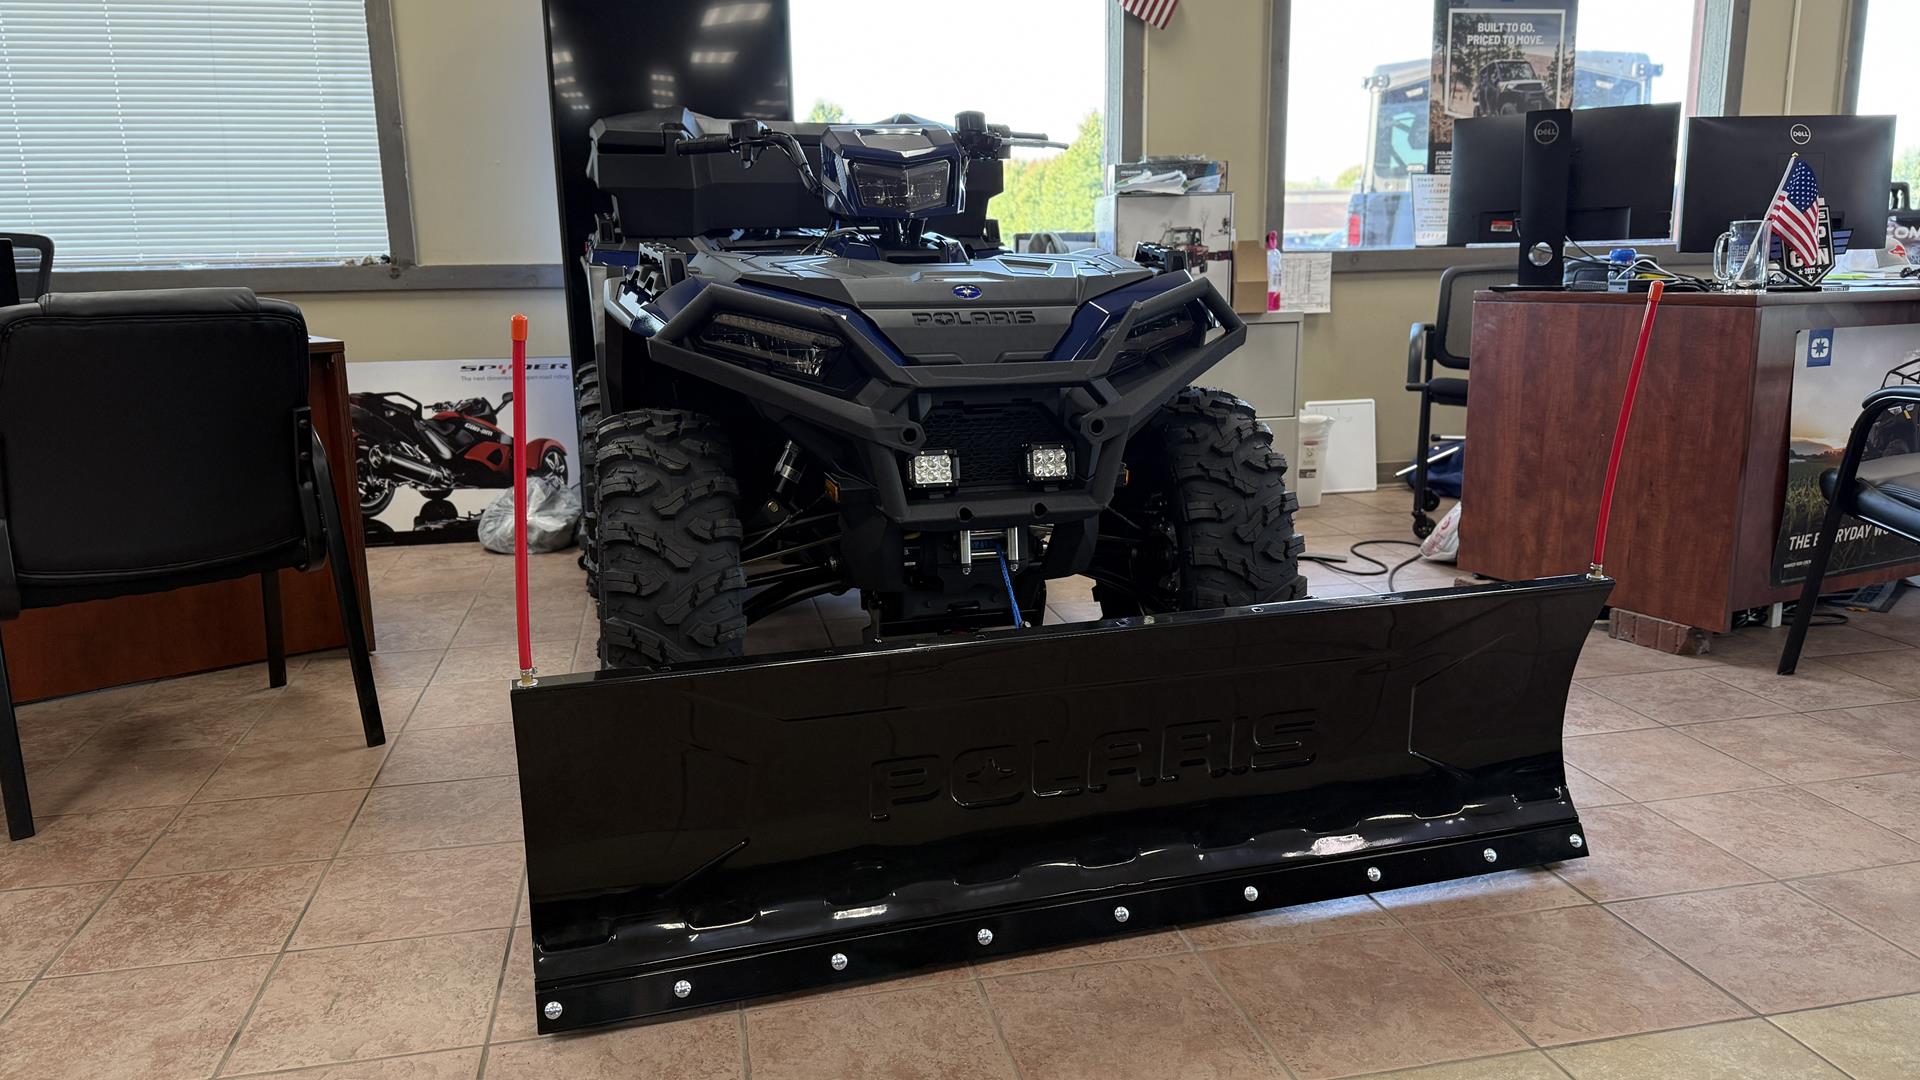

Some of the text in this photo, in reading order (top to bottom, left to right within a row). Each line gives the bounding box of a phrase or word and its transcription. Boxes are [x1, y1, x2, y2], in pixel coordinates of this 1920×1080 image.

[1477, 22, 1535, 33] BUILT TO GO.
[1467, 35, 1500, 45] PRICED
[1502, 35, 1515, 45] TO
[1789, 247, 1830, 268] GN
[912, 310, 1036, 326] POLARIS
[1789, 533, 1813, 551] THE
[1813, 525, 1872, 547] ERYDAY
[869, 707, 1319, 823] POLARIS
